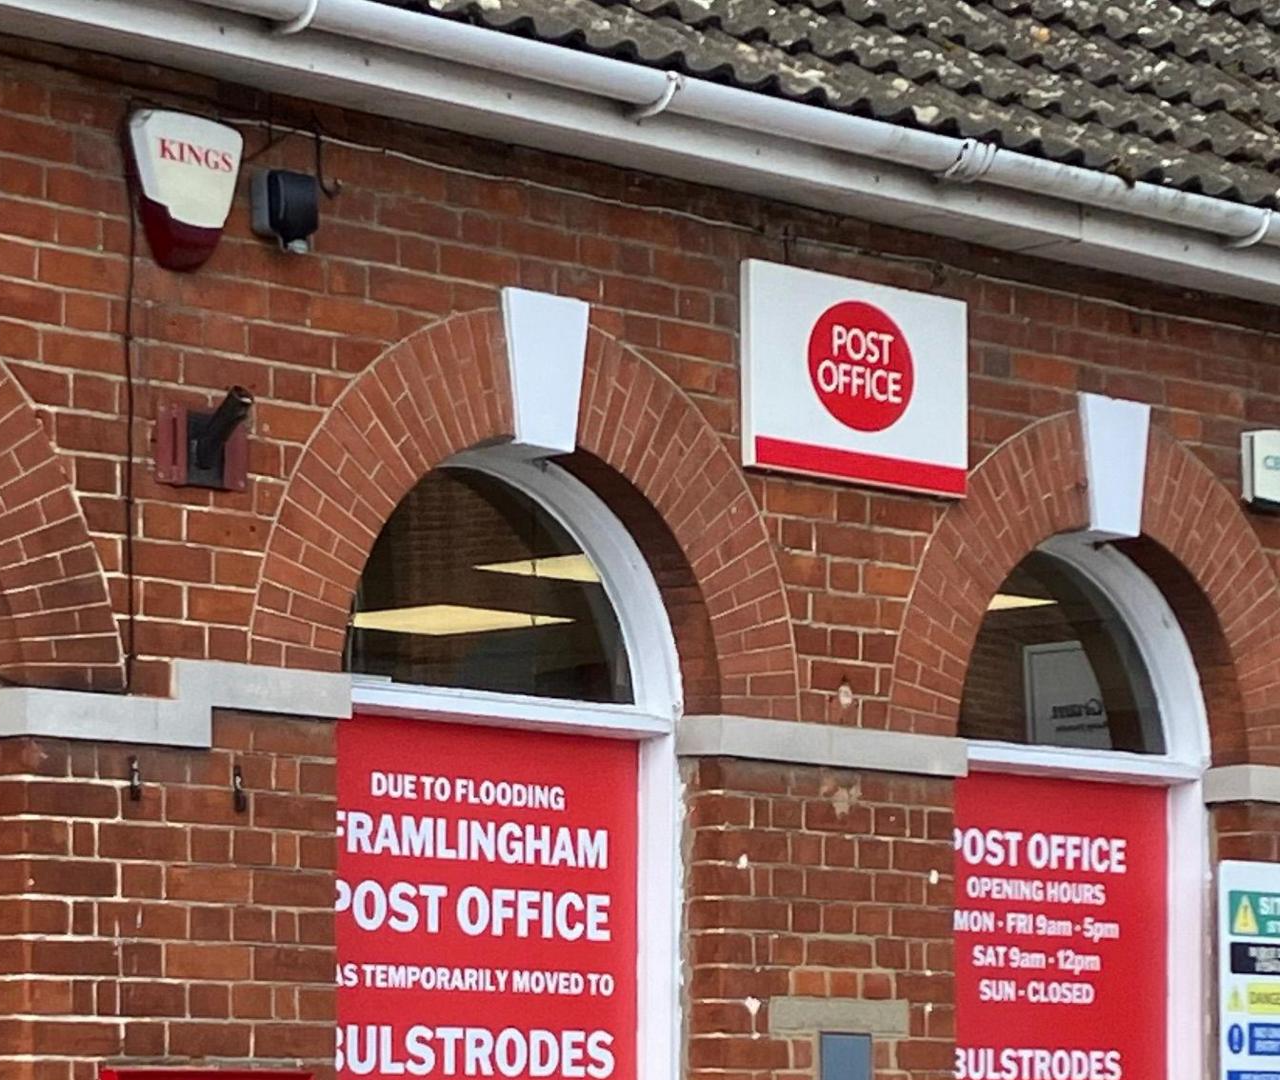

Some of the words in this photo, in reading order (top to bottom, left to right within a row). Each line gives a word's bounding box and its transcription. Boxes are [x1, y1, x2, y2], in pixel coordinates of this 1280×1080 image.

[158, 137, 233, 173] KINGS
[831, 325, 894, 365] POST
[818, 360, 903, 404] OFFICE
[370, 772, 417, 800] DUE
[421, 777, 449, 801] TO
[455, 779, 565, 811] FLOODING
[1027, 833, 1127, 874] OFFICE
[966, 876, 1045, 901] OPENING
[1047, 881, 1106, 905] HOURS
[456, 886, 611, 942] OFFICE
[1006, 912, 1033, 934] FRI
[1035, 914, 1072, 936] 9am
[1083, 917, 1120, 943] 5pm
[972, 946, 1010, 968] SAT
[1010, 947, 1046, 969] 9am
[1056, 948, 1102, 975] 12pm
[362, 964, 507, 993] TEMPORARILY
[512, 969, 585, 996] MOVED
[587, 974, 615, 997] TO
[979, 979, 1017, 1002] SUN
[1026, 981, 1095, 1004] CLOSED
